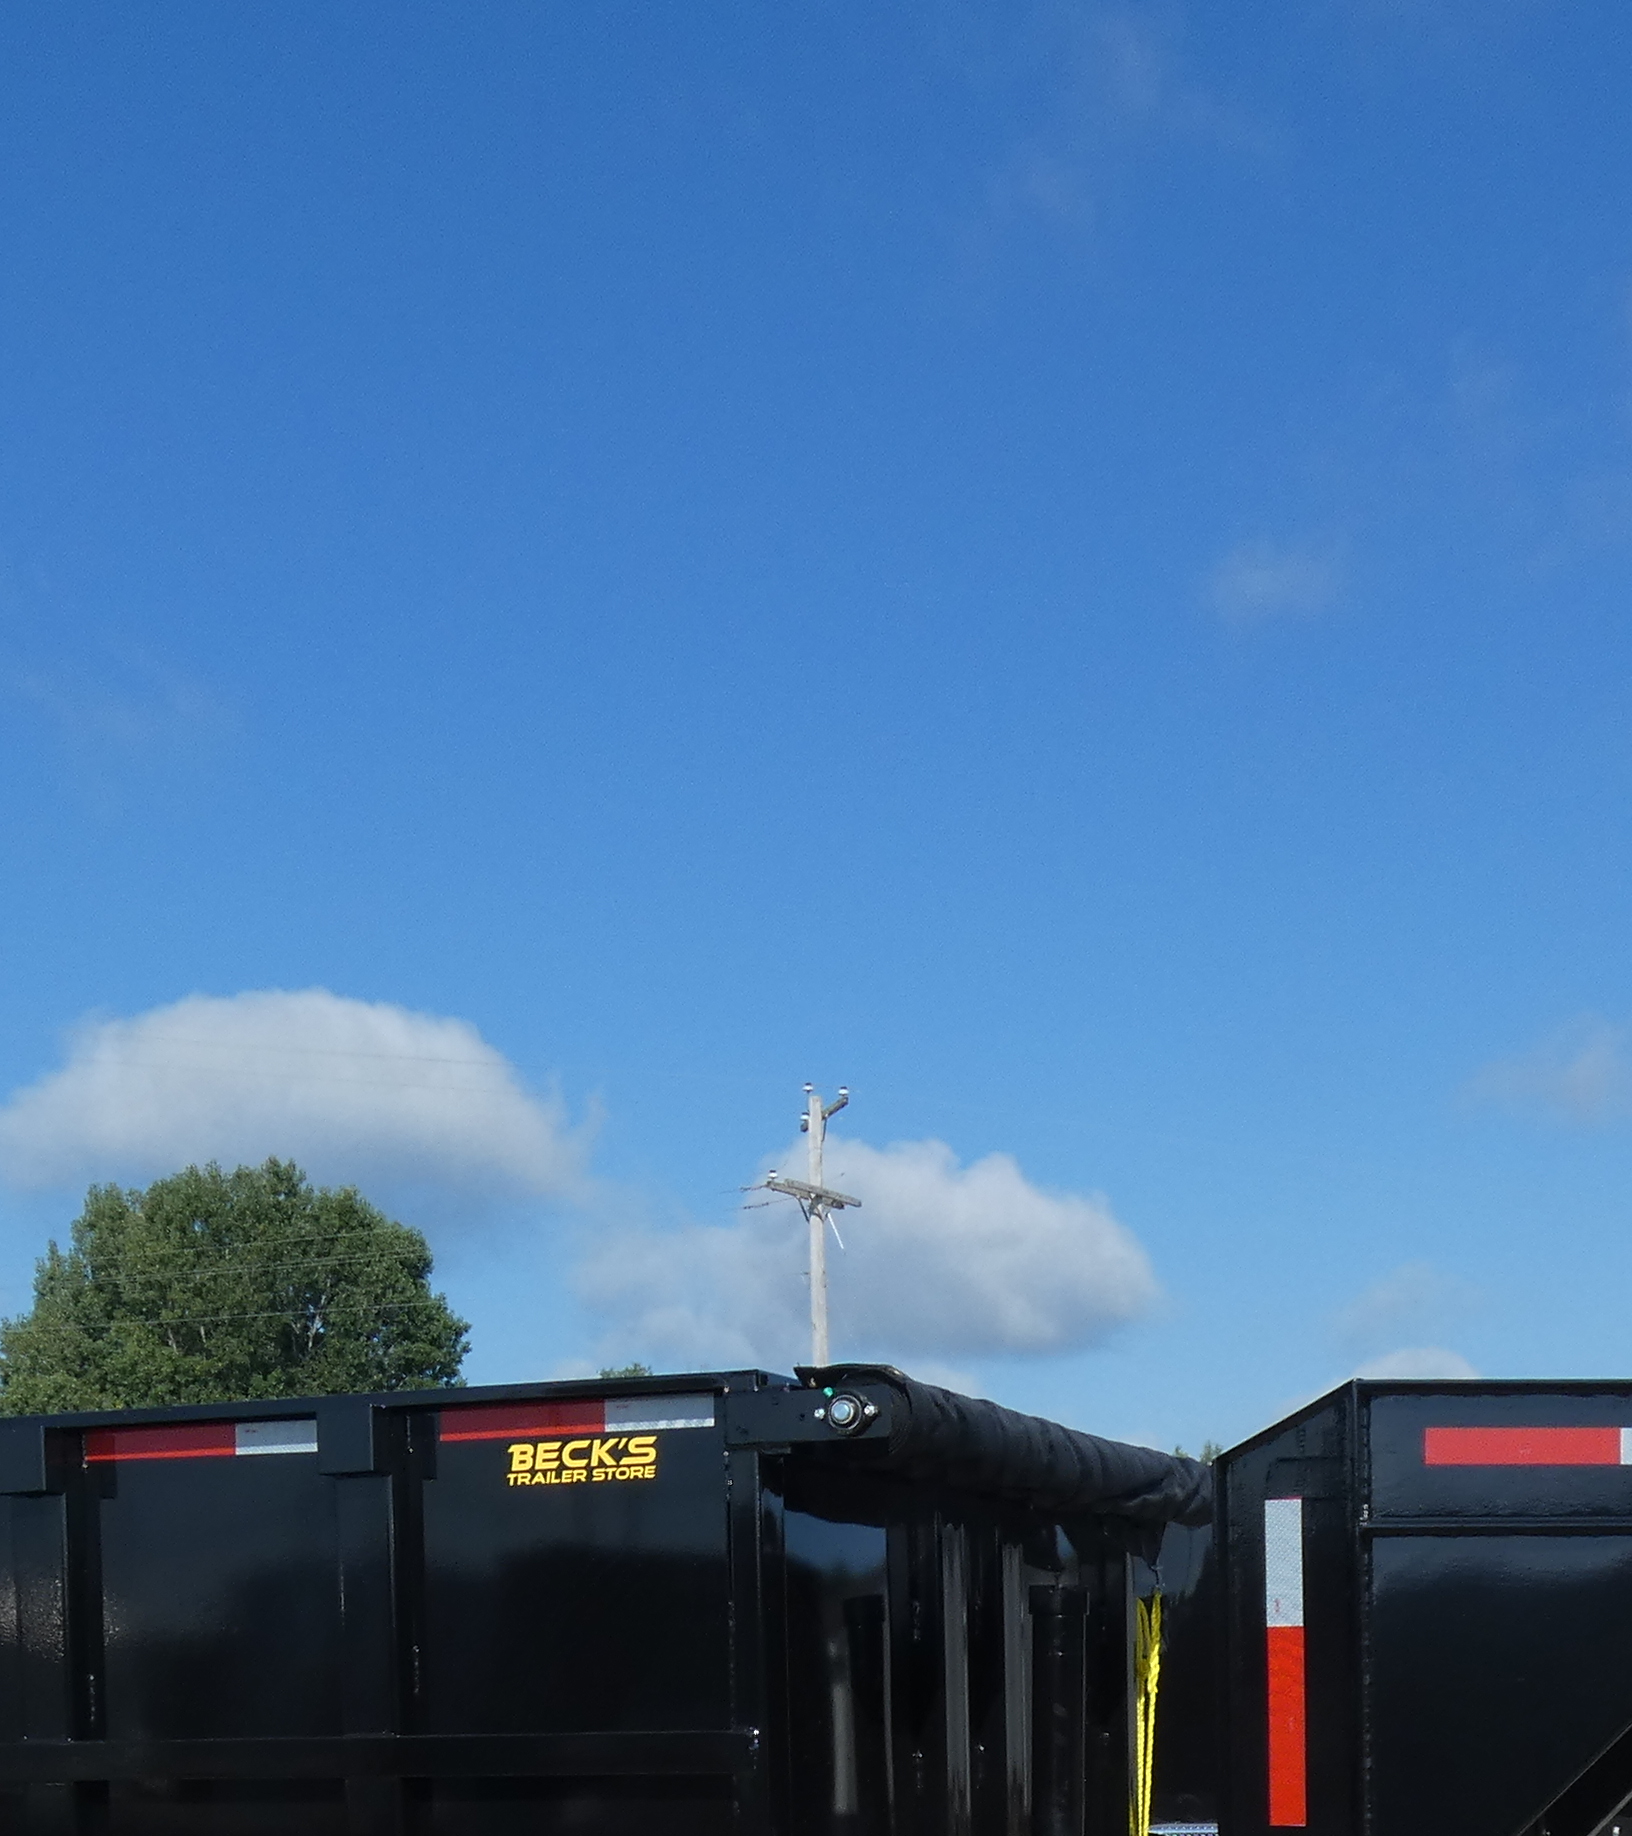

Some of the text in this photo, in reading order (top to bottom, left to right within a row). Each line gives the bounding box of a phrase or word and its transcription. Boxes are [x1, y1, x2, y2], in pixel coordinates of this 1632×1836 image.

[507, 1435, 658, 1473] BECK'S
[506, 1464, 657, 1487] TRAILER STORE
